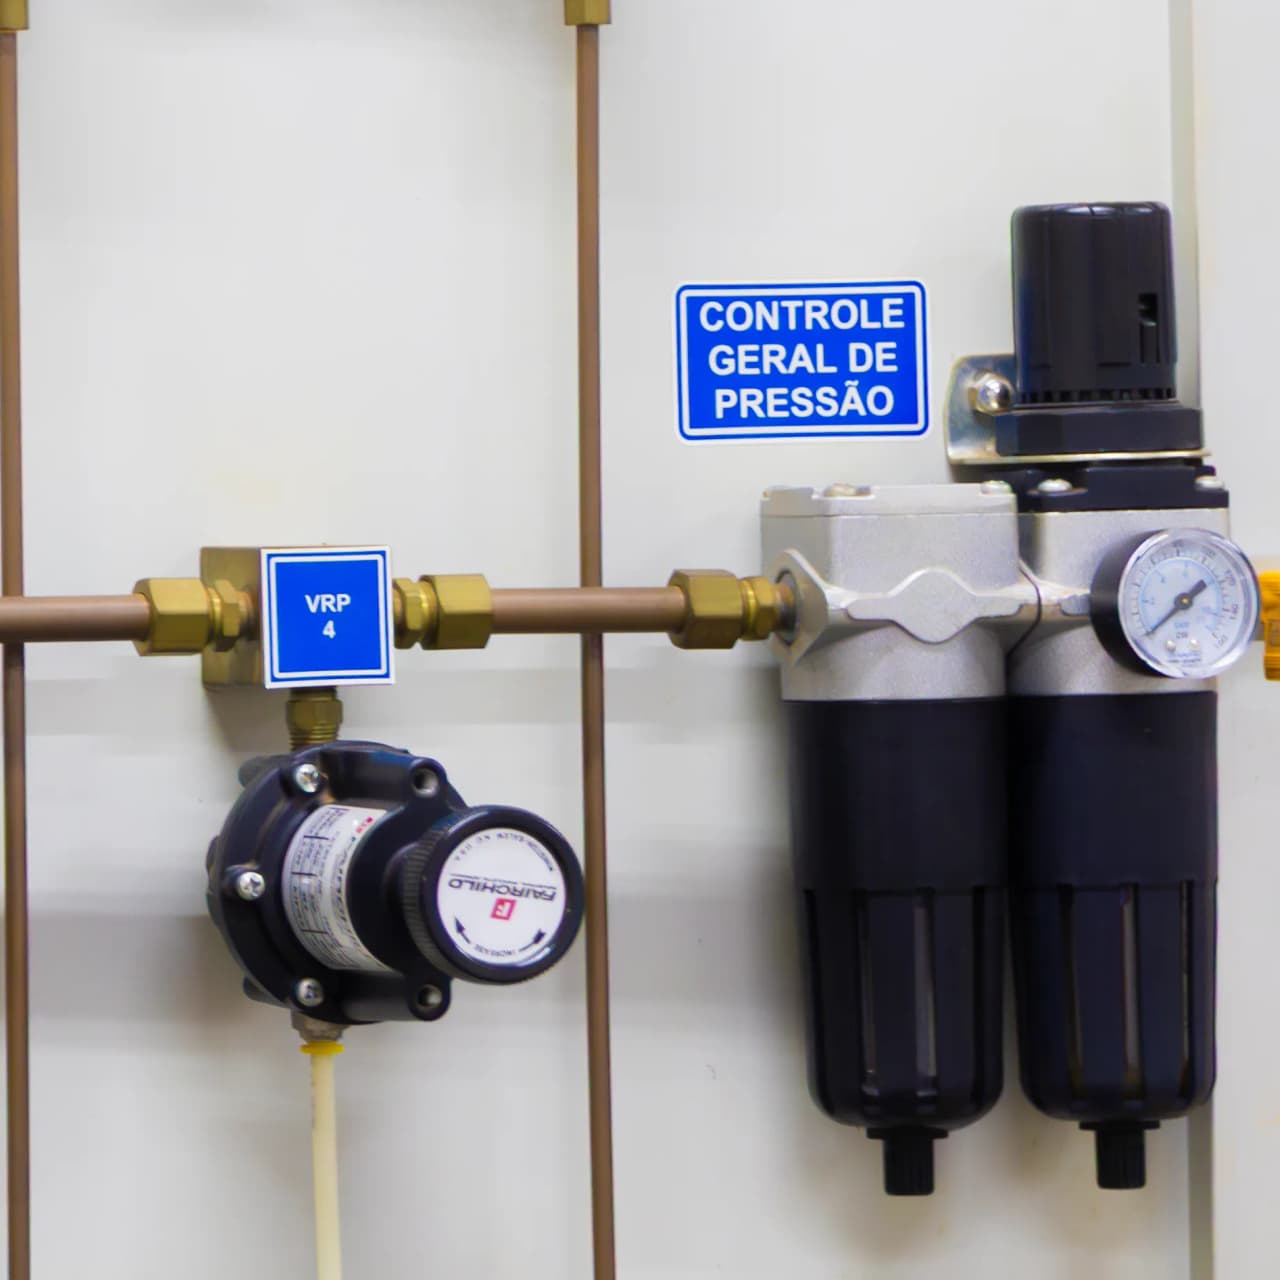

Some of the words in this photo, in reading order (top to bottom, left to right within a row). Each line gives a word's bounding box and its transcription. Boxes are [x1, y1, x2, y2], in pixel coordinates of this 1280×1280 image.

[699, 297, 905, 332] CONTROLE
[708, 343, 838, 376] GERAL
[848, 341, 898, 373] DE
[715, 380, 894, 419] PRESSÃO
[304, 593, 352, 613] VRP
[321, 619, 337, 639] 4
[447, 877, 557, 902] FAIRCHILD
